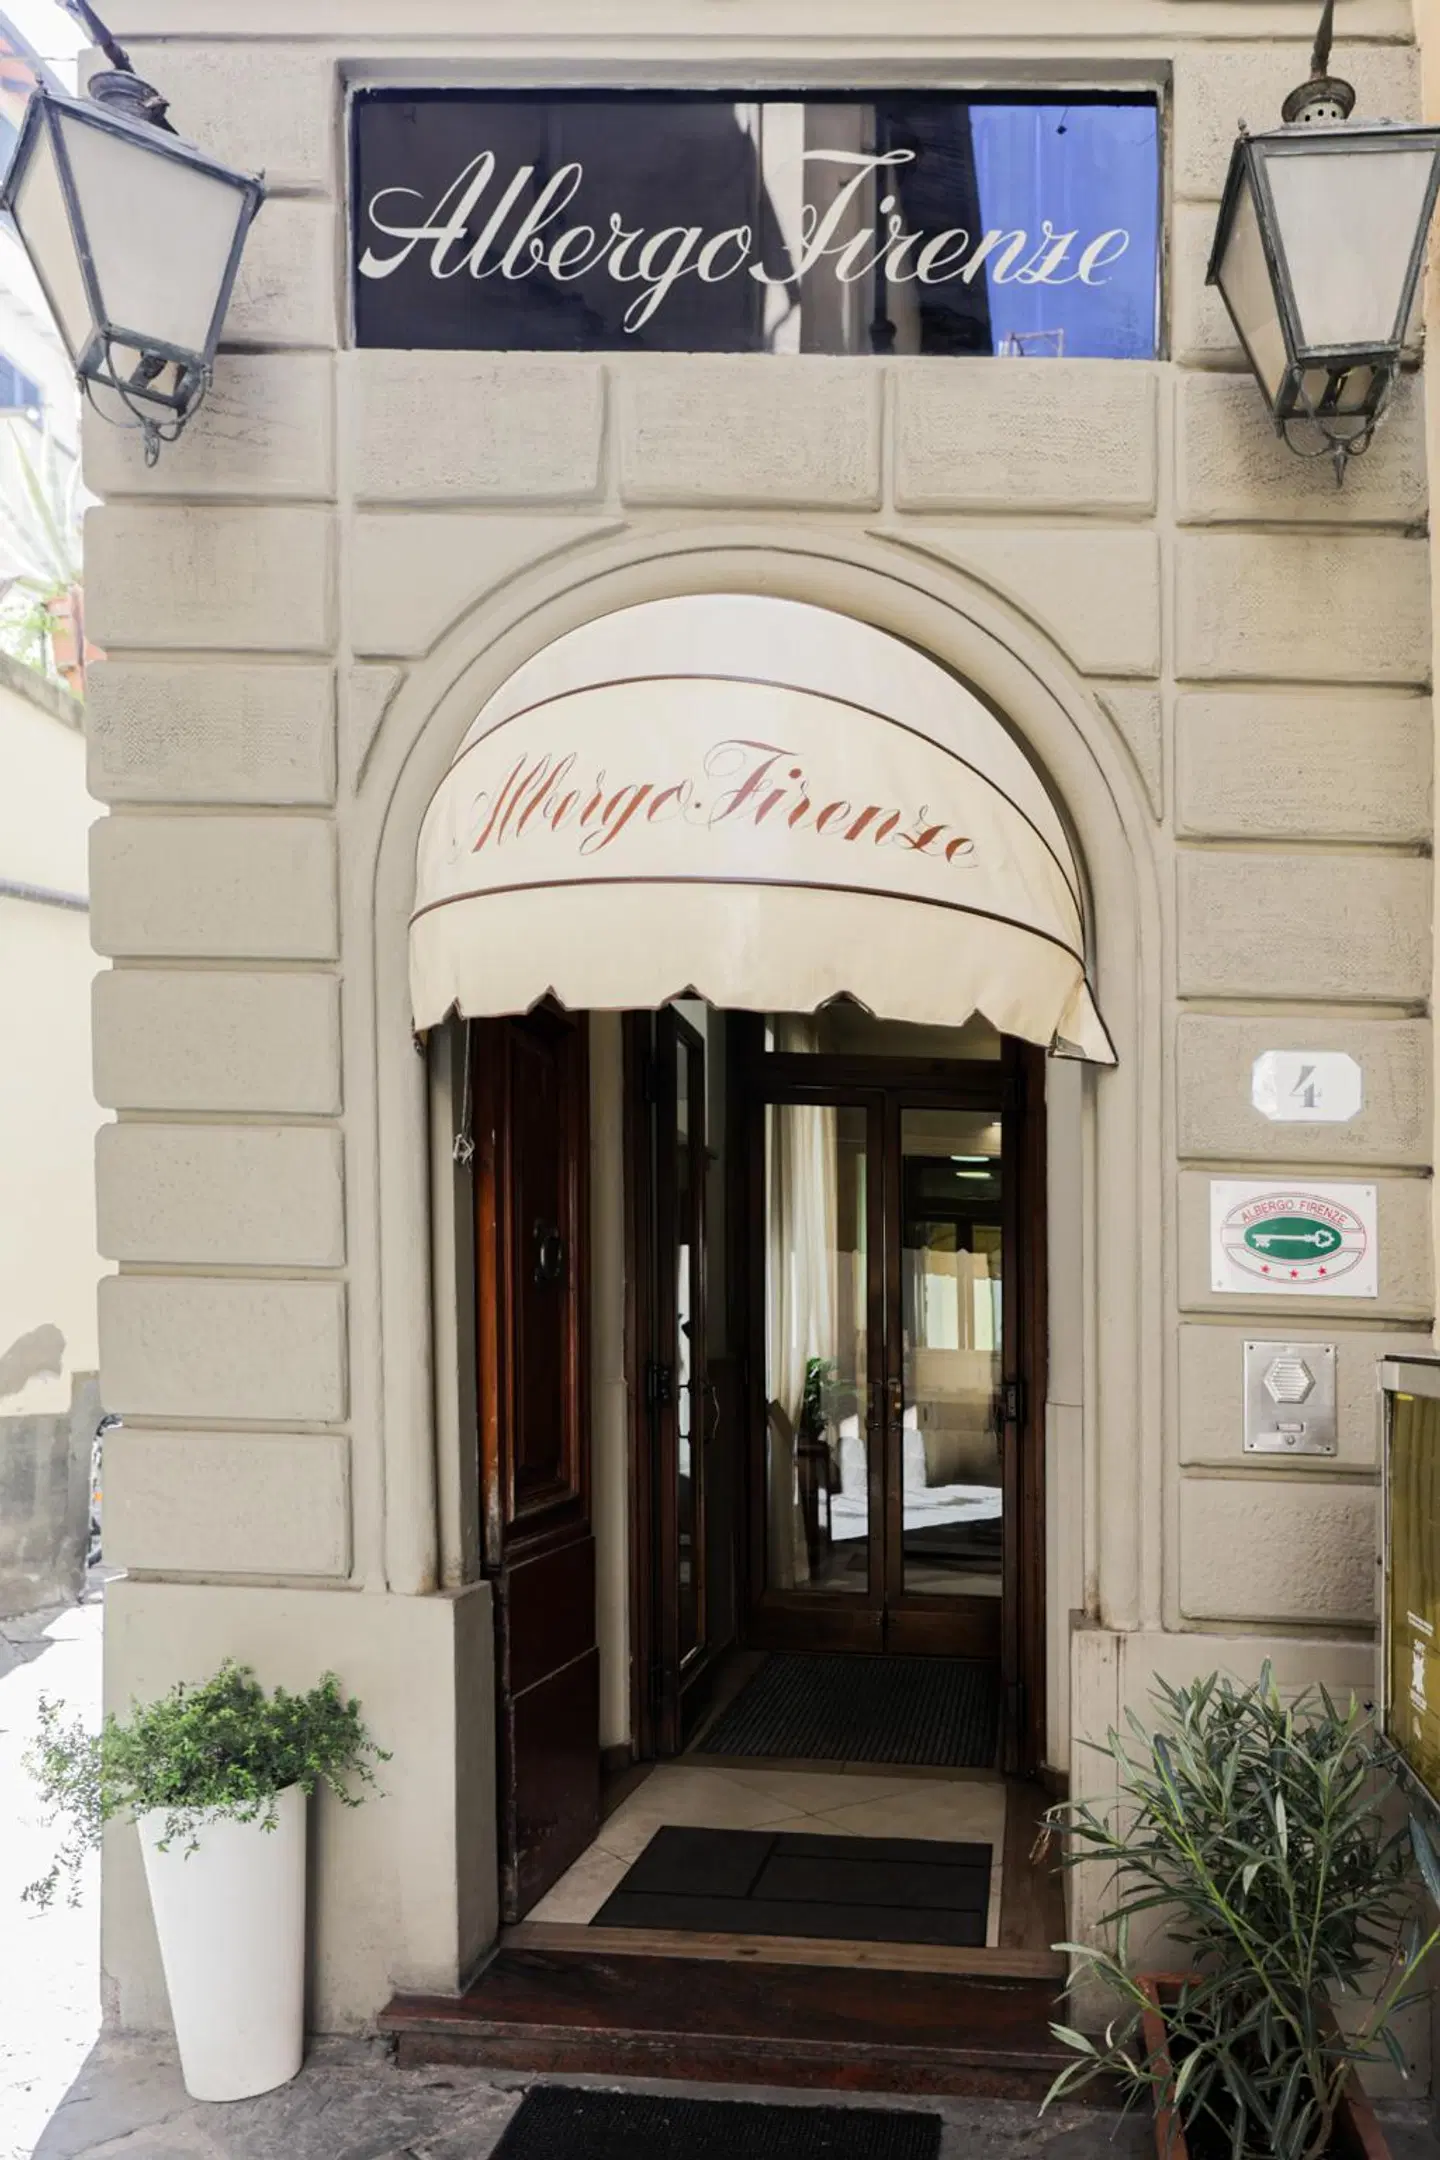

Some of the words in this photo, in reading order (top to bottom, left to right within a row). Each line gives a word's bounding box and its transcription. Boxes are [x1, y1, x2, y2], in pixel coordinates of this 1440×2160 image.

[358, 149, 752, 333] Albergo
[749, 149, 1131, 287] Firenze
[450, 751, 696, 862] Albergo
[686, 738, 979, 869] Firenze
[1288, 1064, 1322, 1109] 4
[1241, 1199, 1295, 1225] ALBERGO
[1299, 1200, 1349, 1226] FIRENZE
